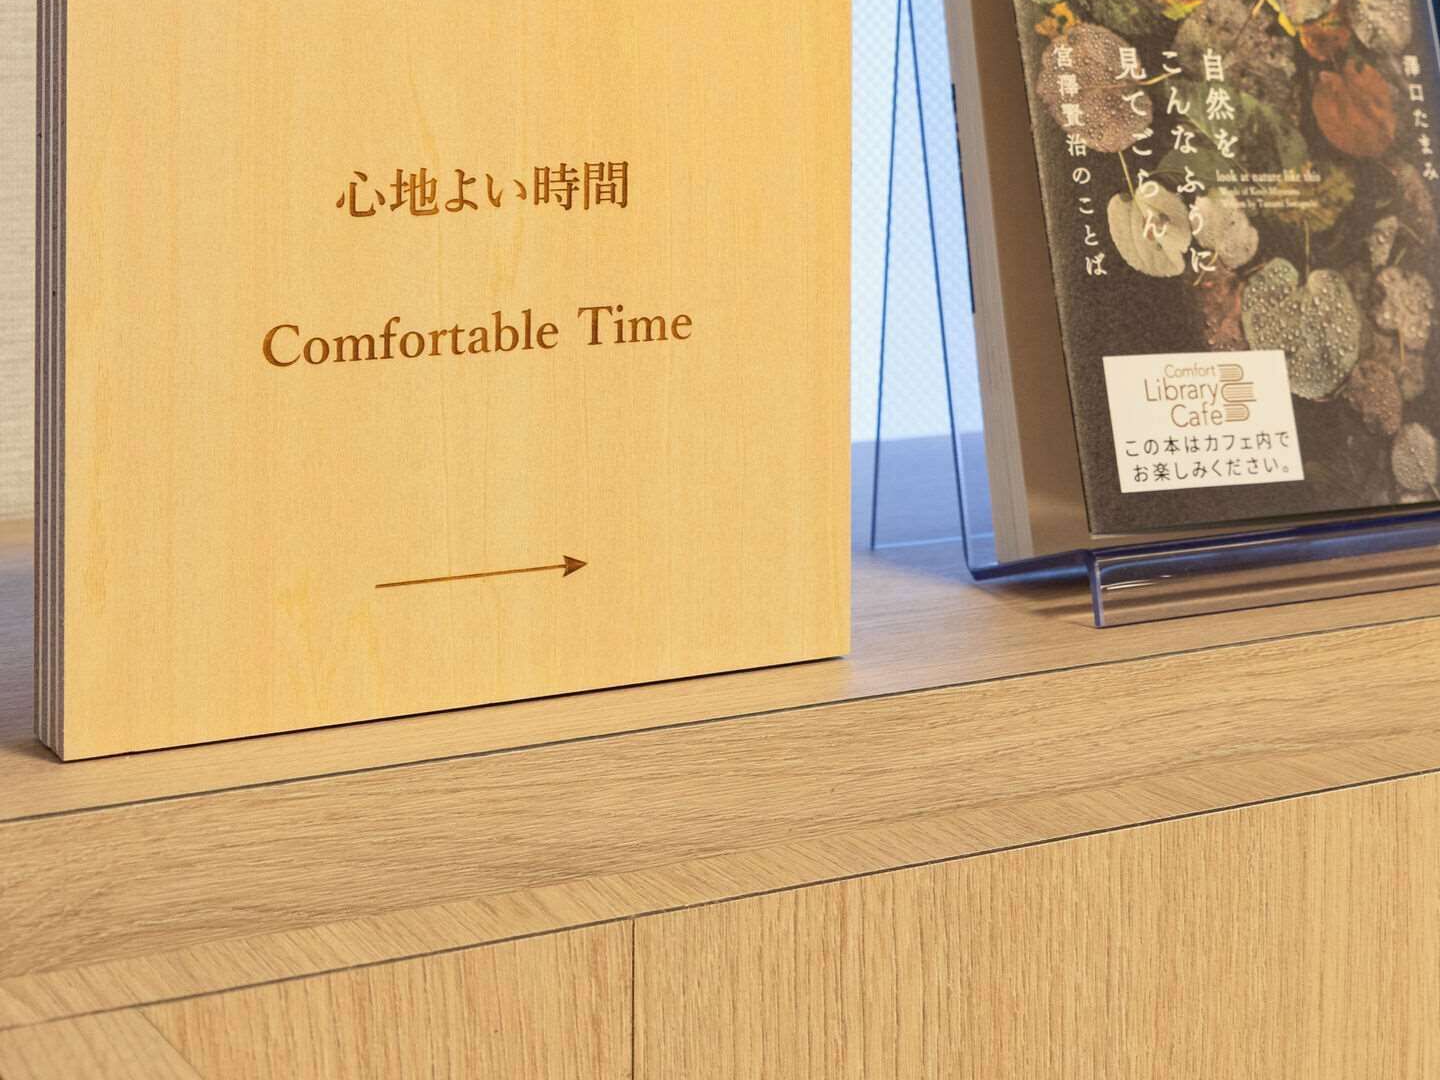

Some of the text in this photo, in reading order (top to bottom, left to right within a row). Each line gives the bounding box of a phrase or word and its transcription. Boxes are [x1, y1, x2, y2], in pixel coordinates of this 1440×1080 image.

[1203, 49, 1239, 159] 自然を
[1116, 47, 1168, 239] 見てごらん
[1161, 51, 1217, 273] こんなふうに
[335, 160, 630, 218] 心地よい時間
[262, 304, 693, 367] Comfortable Time
[1144, 378, 1218, 406] Library
[1164, 362, 1216, 379] Comfort
[1125, 431, 1290, 457] この本はカフェ内で
[1133, 457, 1291, 483] お楽しみください。
